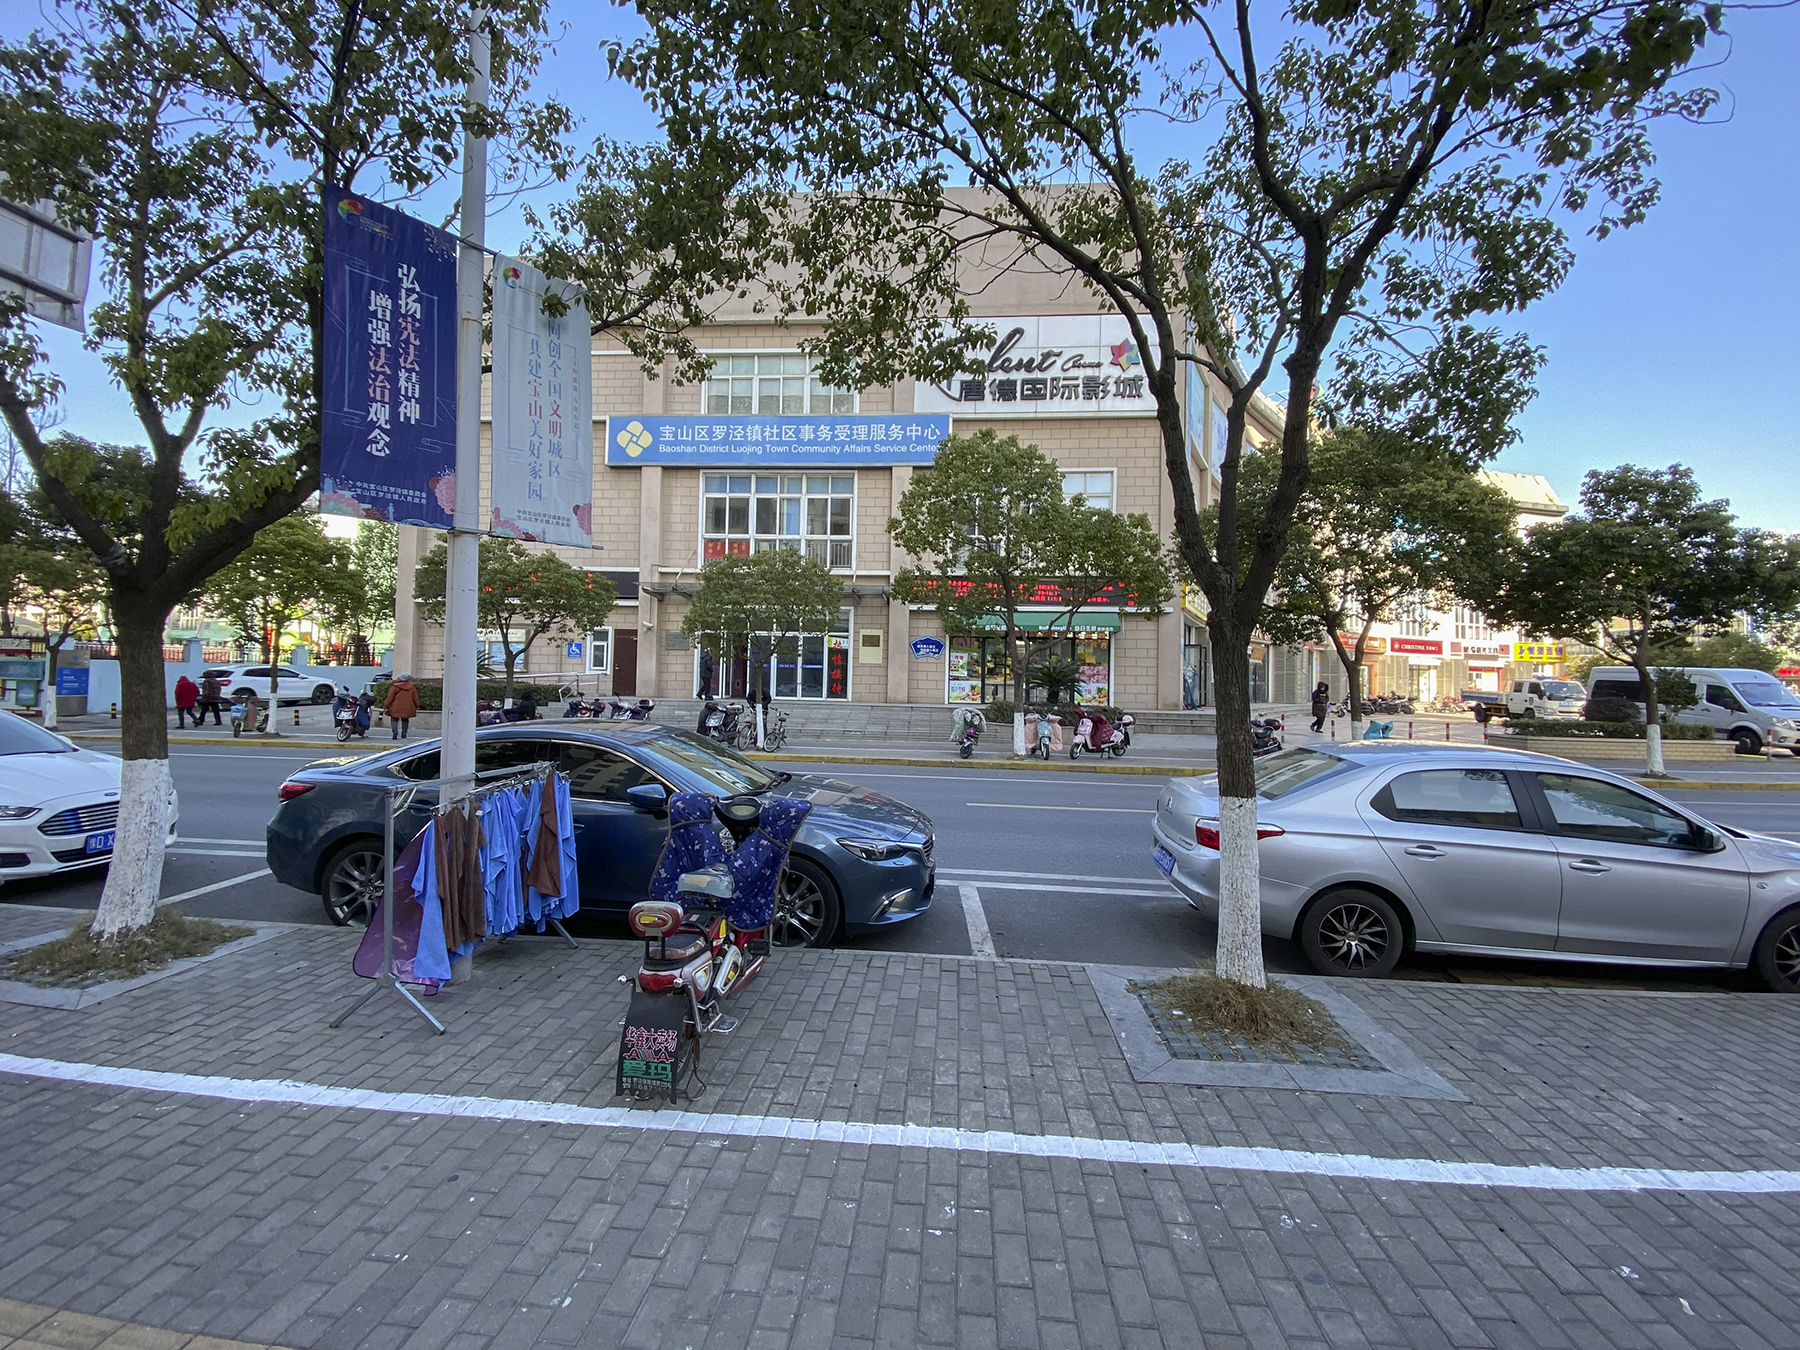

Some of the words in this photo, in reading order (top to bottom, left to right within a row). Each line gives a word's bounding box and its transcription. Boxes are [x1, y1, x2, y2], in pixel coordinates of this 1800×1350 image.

[397, 262, 421, 425] 弘扬宪法精神
[366, 290, 392, 457] 增强法治观念
[960, 374, 1144, 402] 唐德国际影城
[527, 338, 543, 502] 共建宝山美好家园
[659, 423, 941, 442] 宝山区罗泾镇社区事务受理服务中心
[659, 444, 697, 453] Baoshan
[700, 444, 729, 453] District
[731, 444, 762, 454] Luojing
[765, 444, 788, 453] Town
[792, 444, 840, 454] Community
[843, 444, 871, 453] Affairs
[874, 443, 907, 453] Service
[356, 481, 427, 498] 中共宝山区罗泾镇委员会
[356, 488, 427, 504] 宝山区罗泾镇人民政府
[625, 1026, 677, 1052] 华鑫大卖场
[622, 1060, 672, 1081] 爱玛
